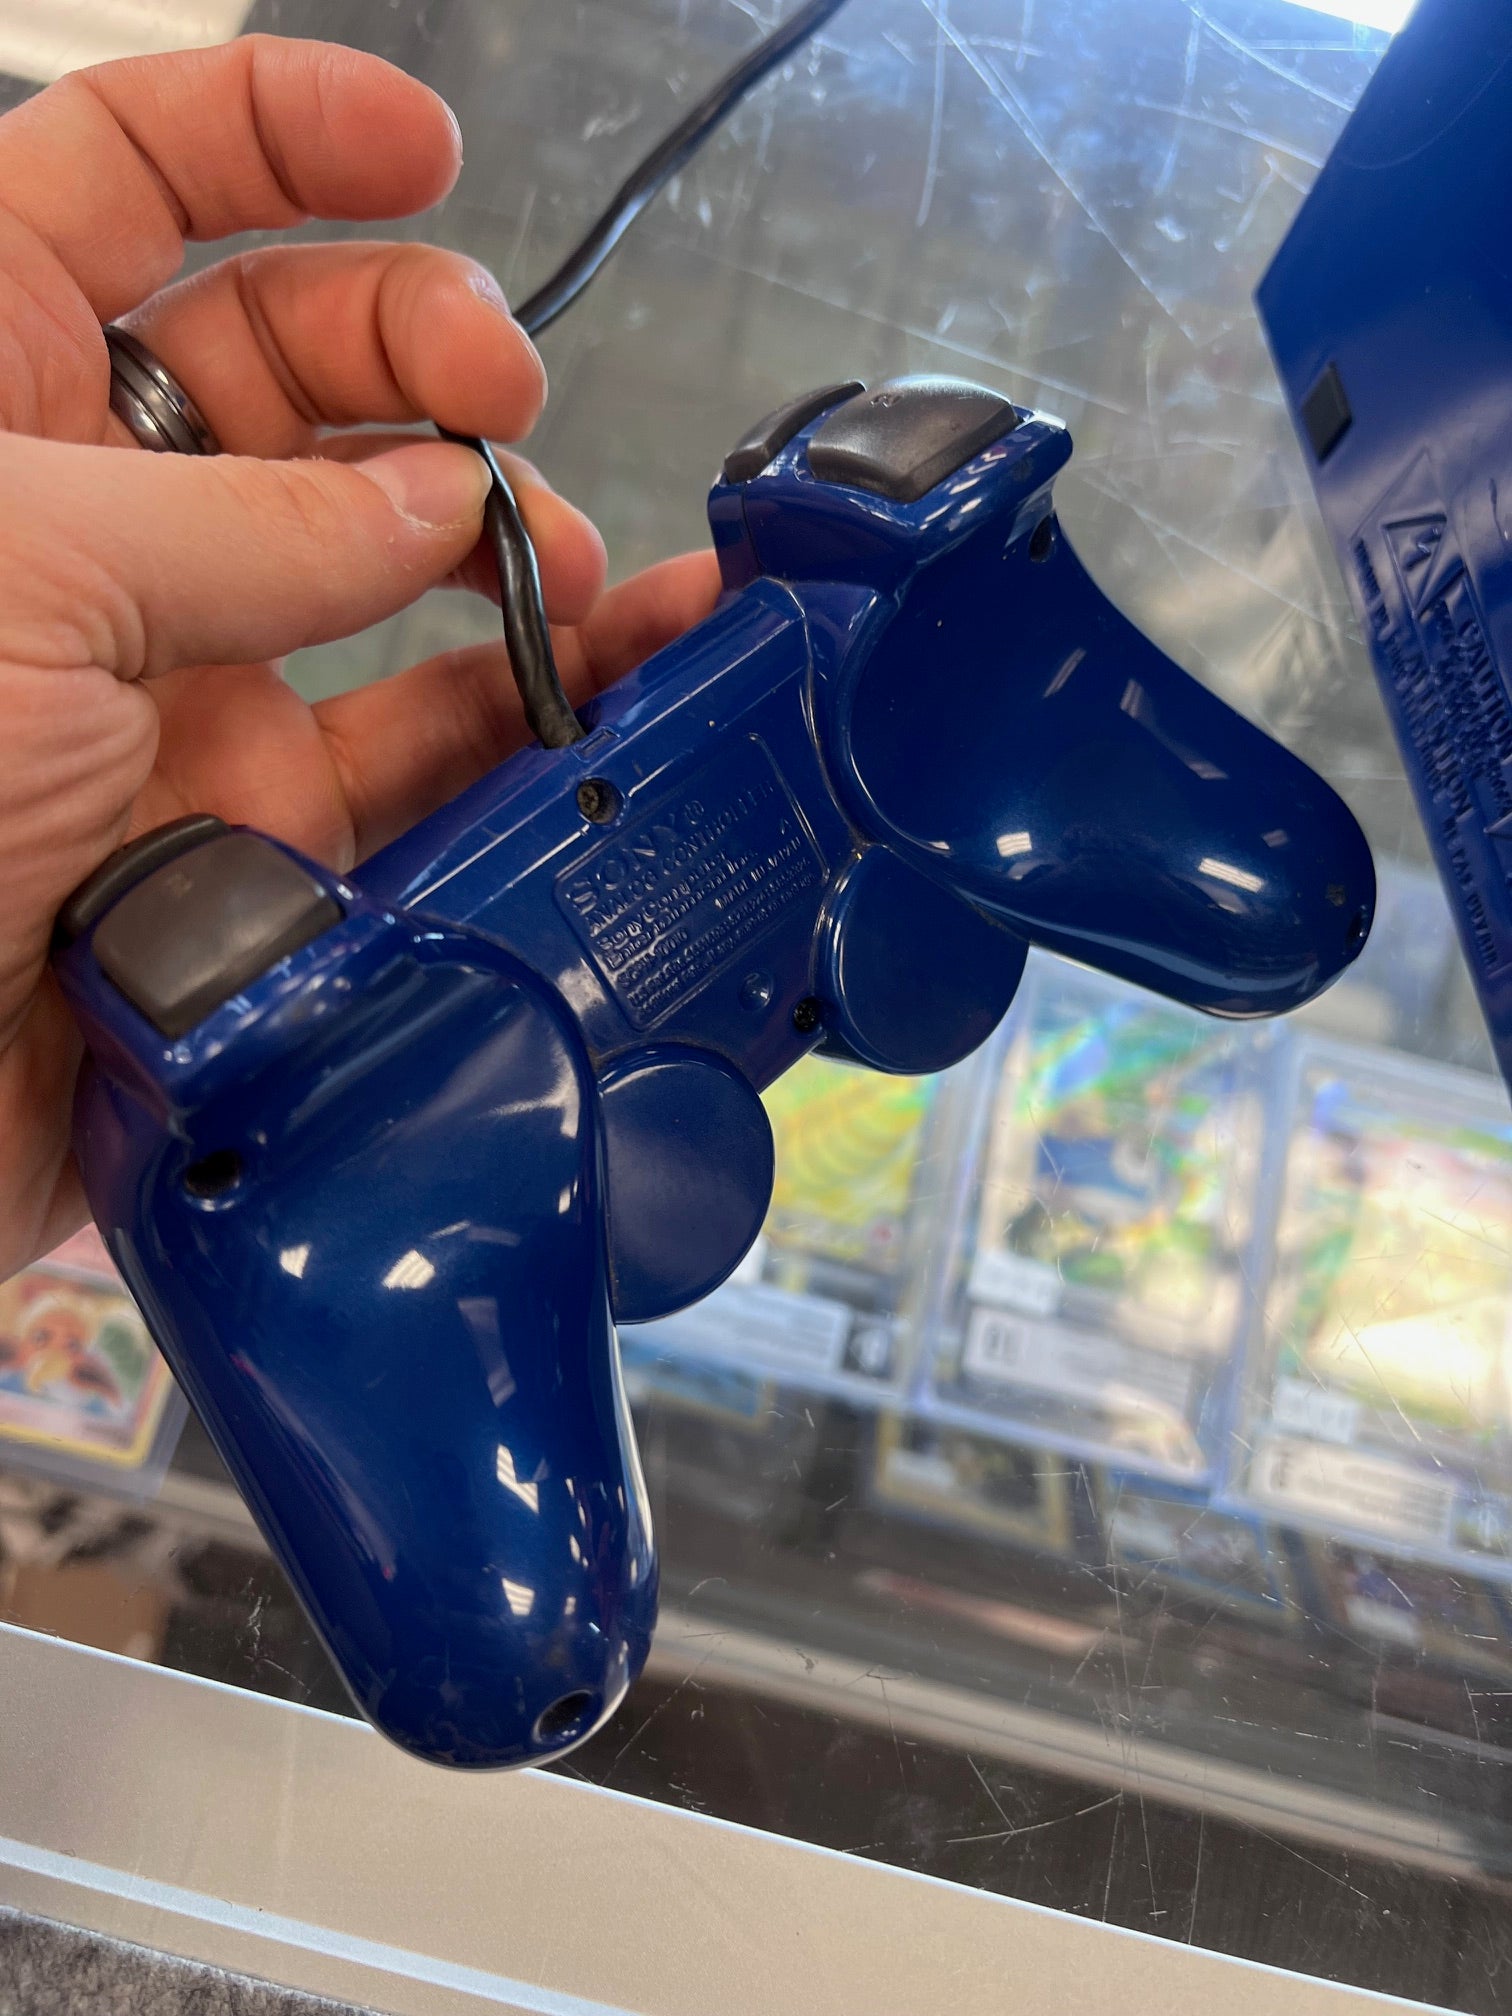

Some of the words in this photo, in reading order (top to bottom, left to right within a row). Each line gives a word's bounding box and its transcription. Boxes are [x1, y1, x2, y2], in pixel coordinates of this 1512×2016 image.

[562, 812, 683, 917] SONY
[583, 868, 659, 937] ANALOG
[596, 912, 644, 952] Sony
